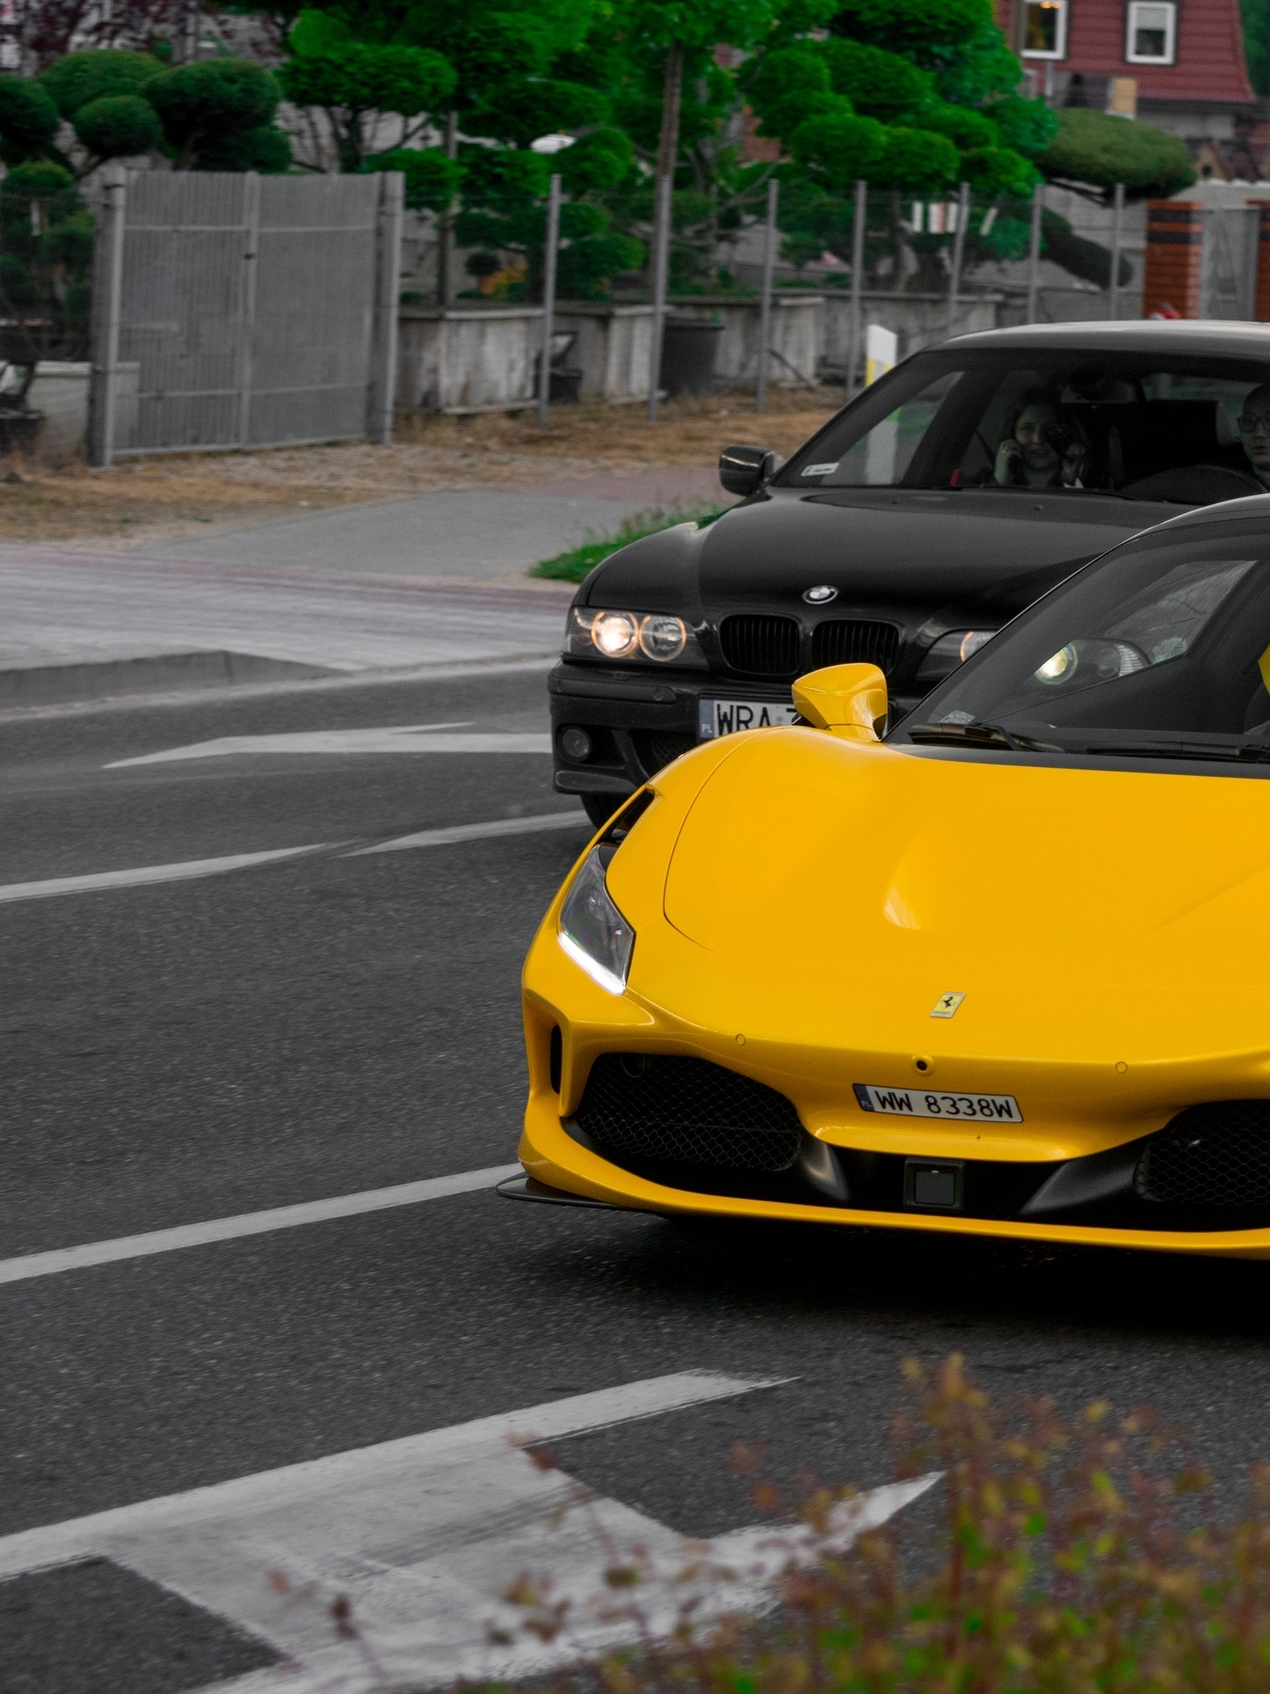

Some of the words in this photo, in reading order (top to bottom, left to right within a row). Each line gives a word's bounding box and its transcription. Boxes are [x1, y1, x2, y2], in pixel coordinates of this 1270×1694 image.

[701, 723, 713, 734] PL
[716, 703, 771, 736] WRA
[874, 1090, 914, 1112] WW
[924, 1094, 1014, 1118] 8338W
